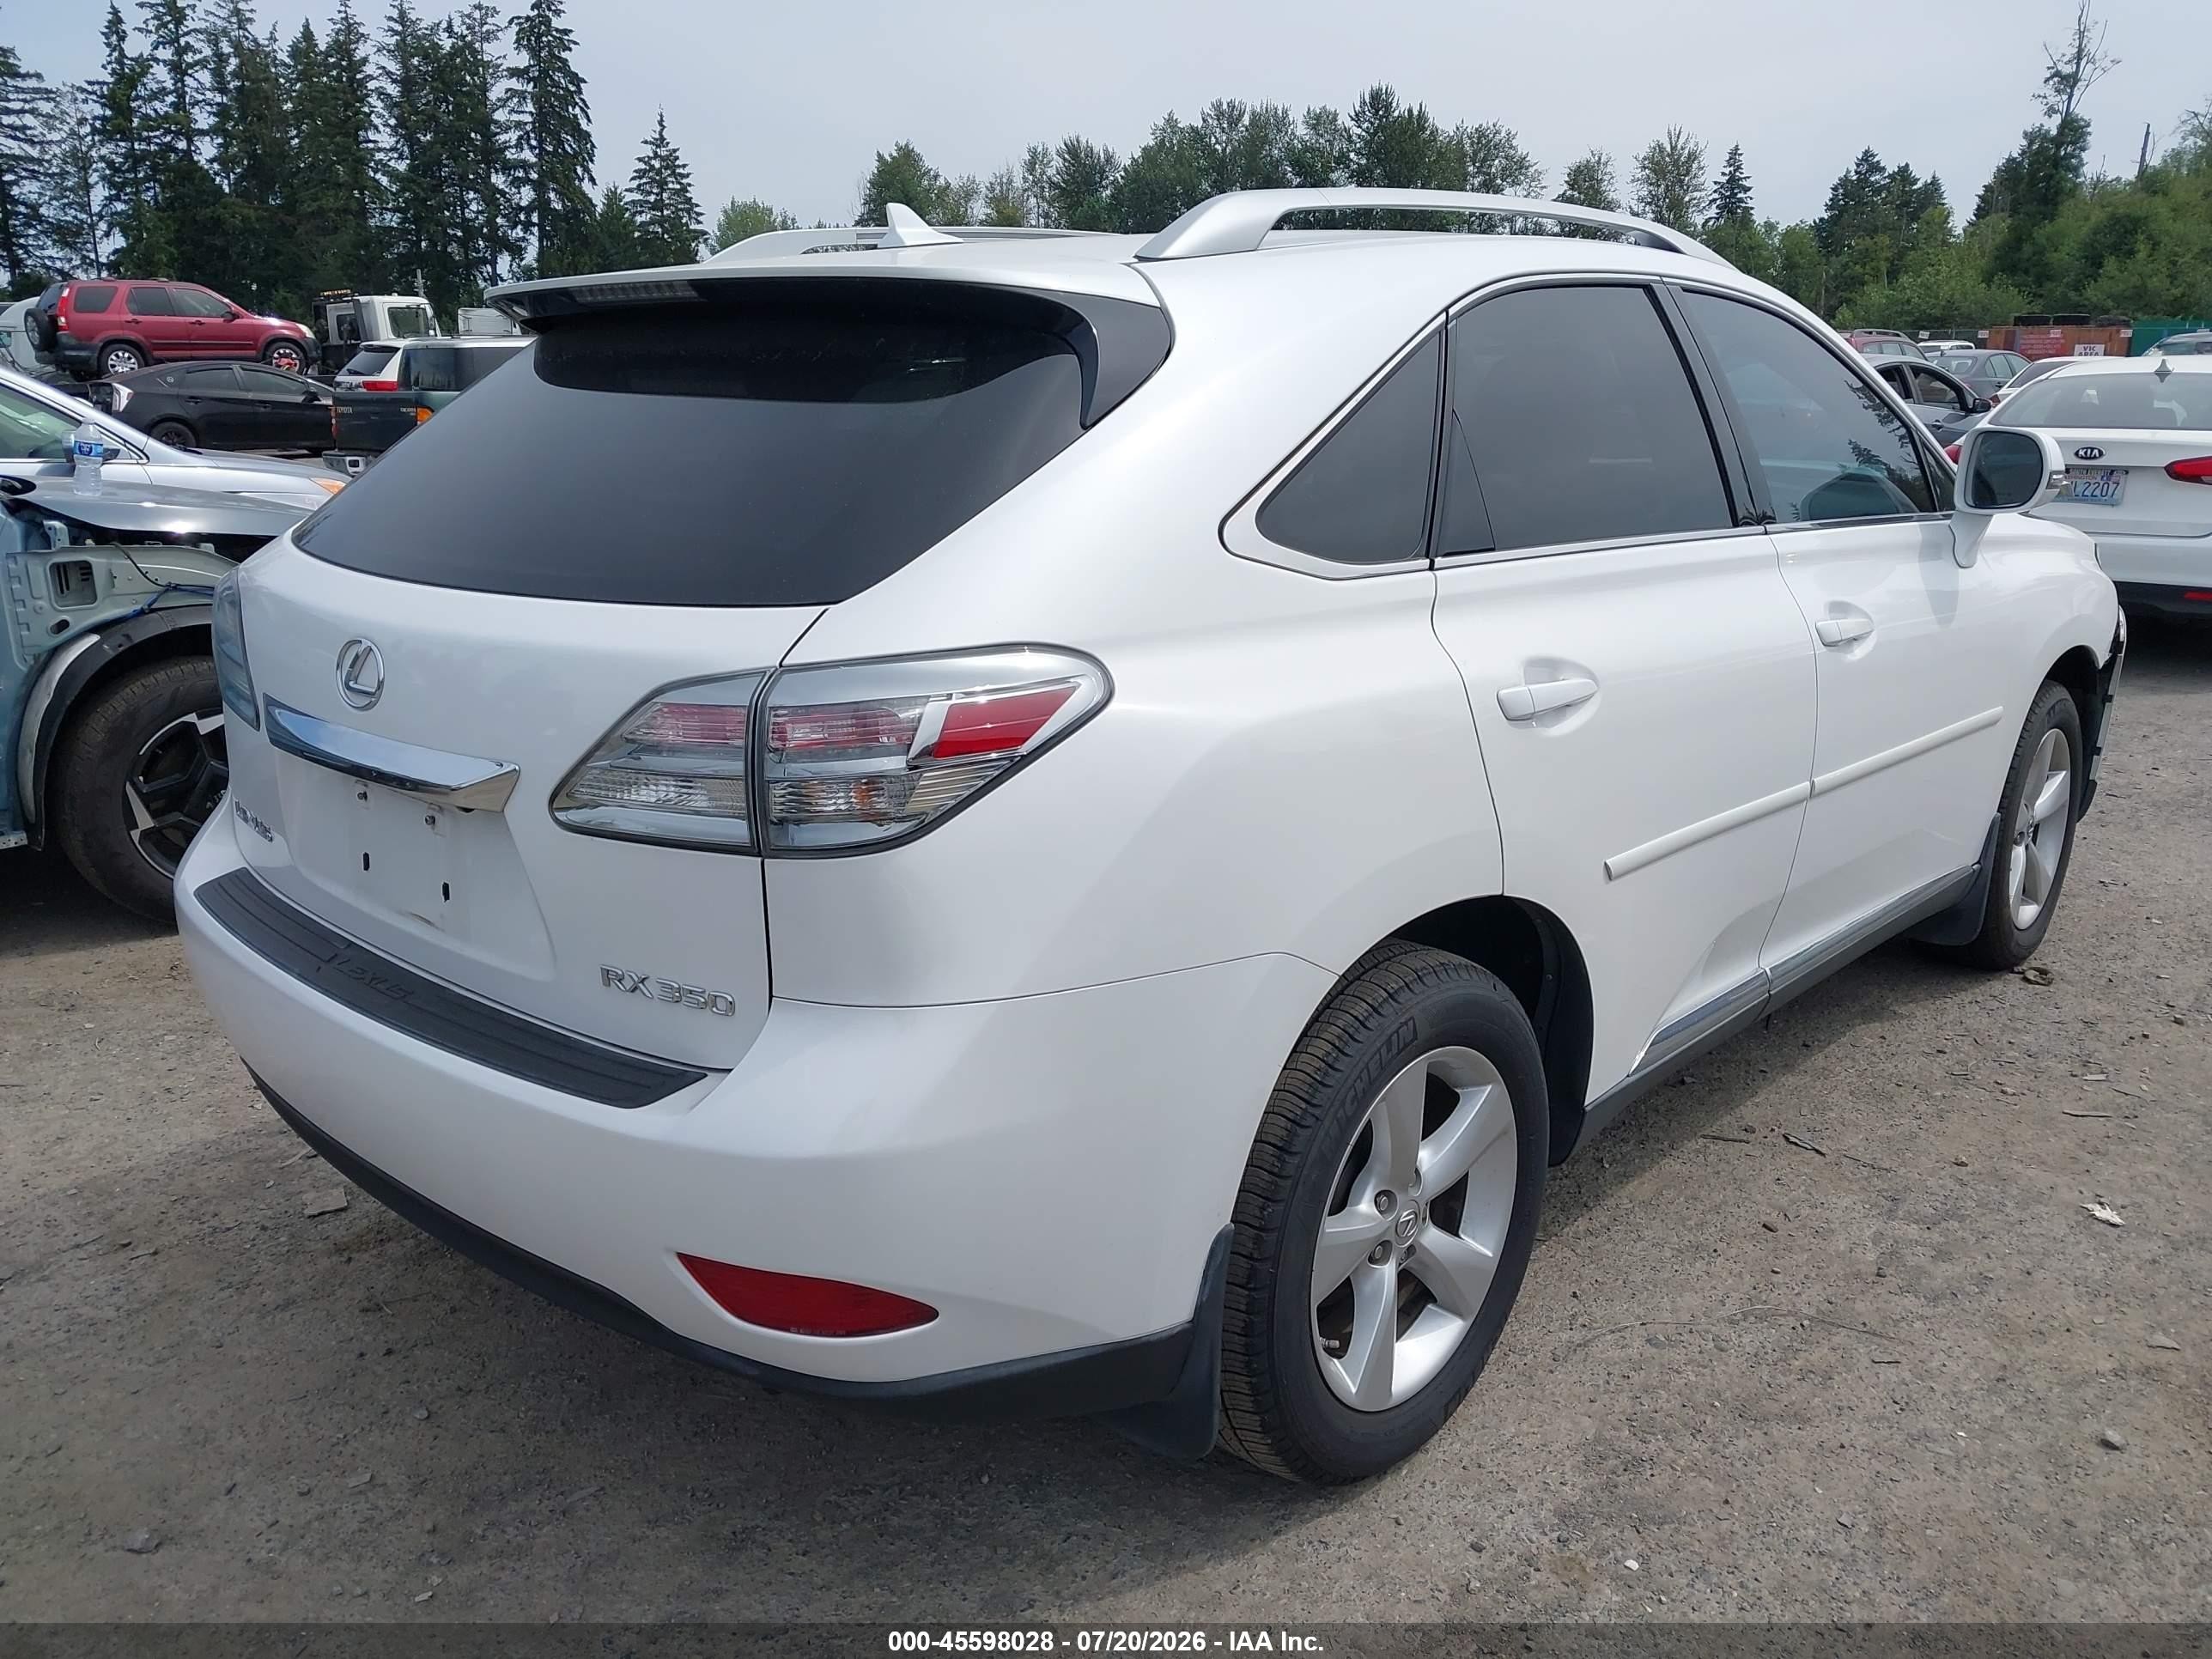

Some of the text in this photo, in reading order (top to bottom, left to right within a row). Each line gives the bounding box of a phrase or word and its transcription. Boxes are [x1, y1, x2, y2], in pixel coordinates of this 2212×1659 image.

[2078, 448, 2100, 458] KIA
[2070, 480, 2120, 498] L2207
[332, 957, 415, 1000] LEXUS
[1320, 1015, 1419, 1152] MICHELIN
